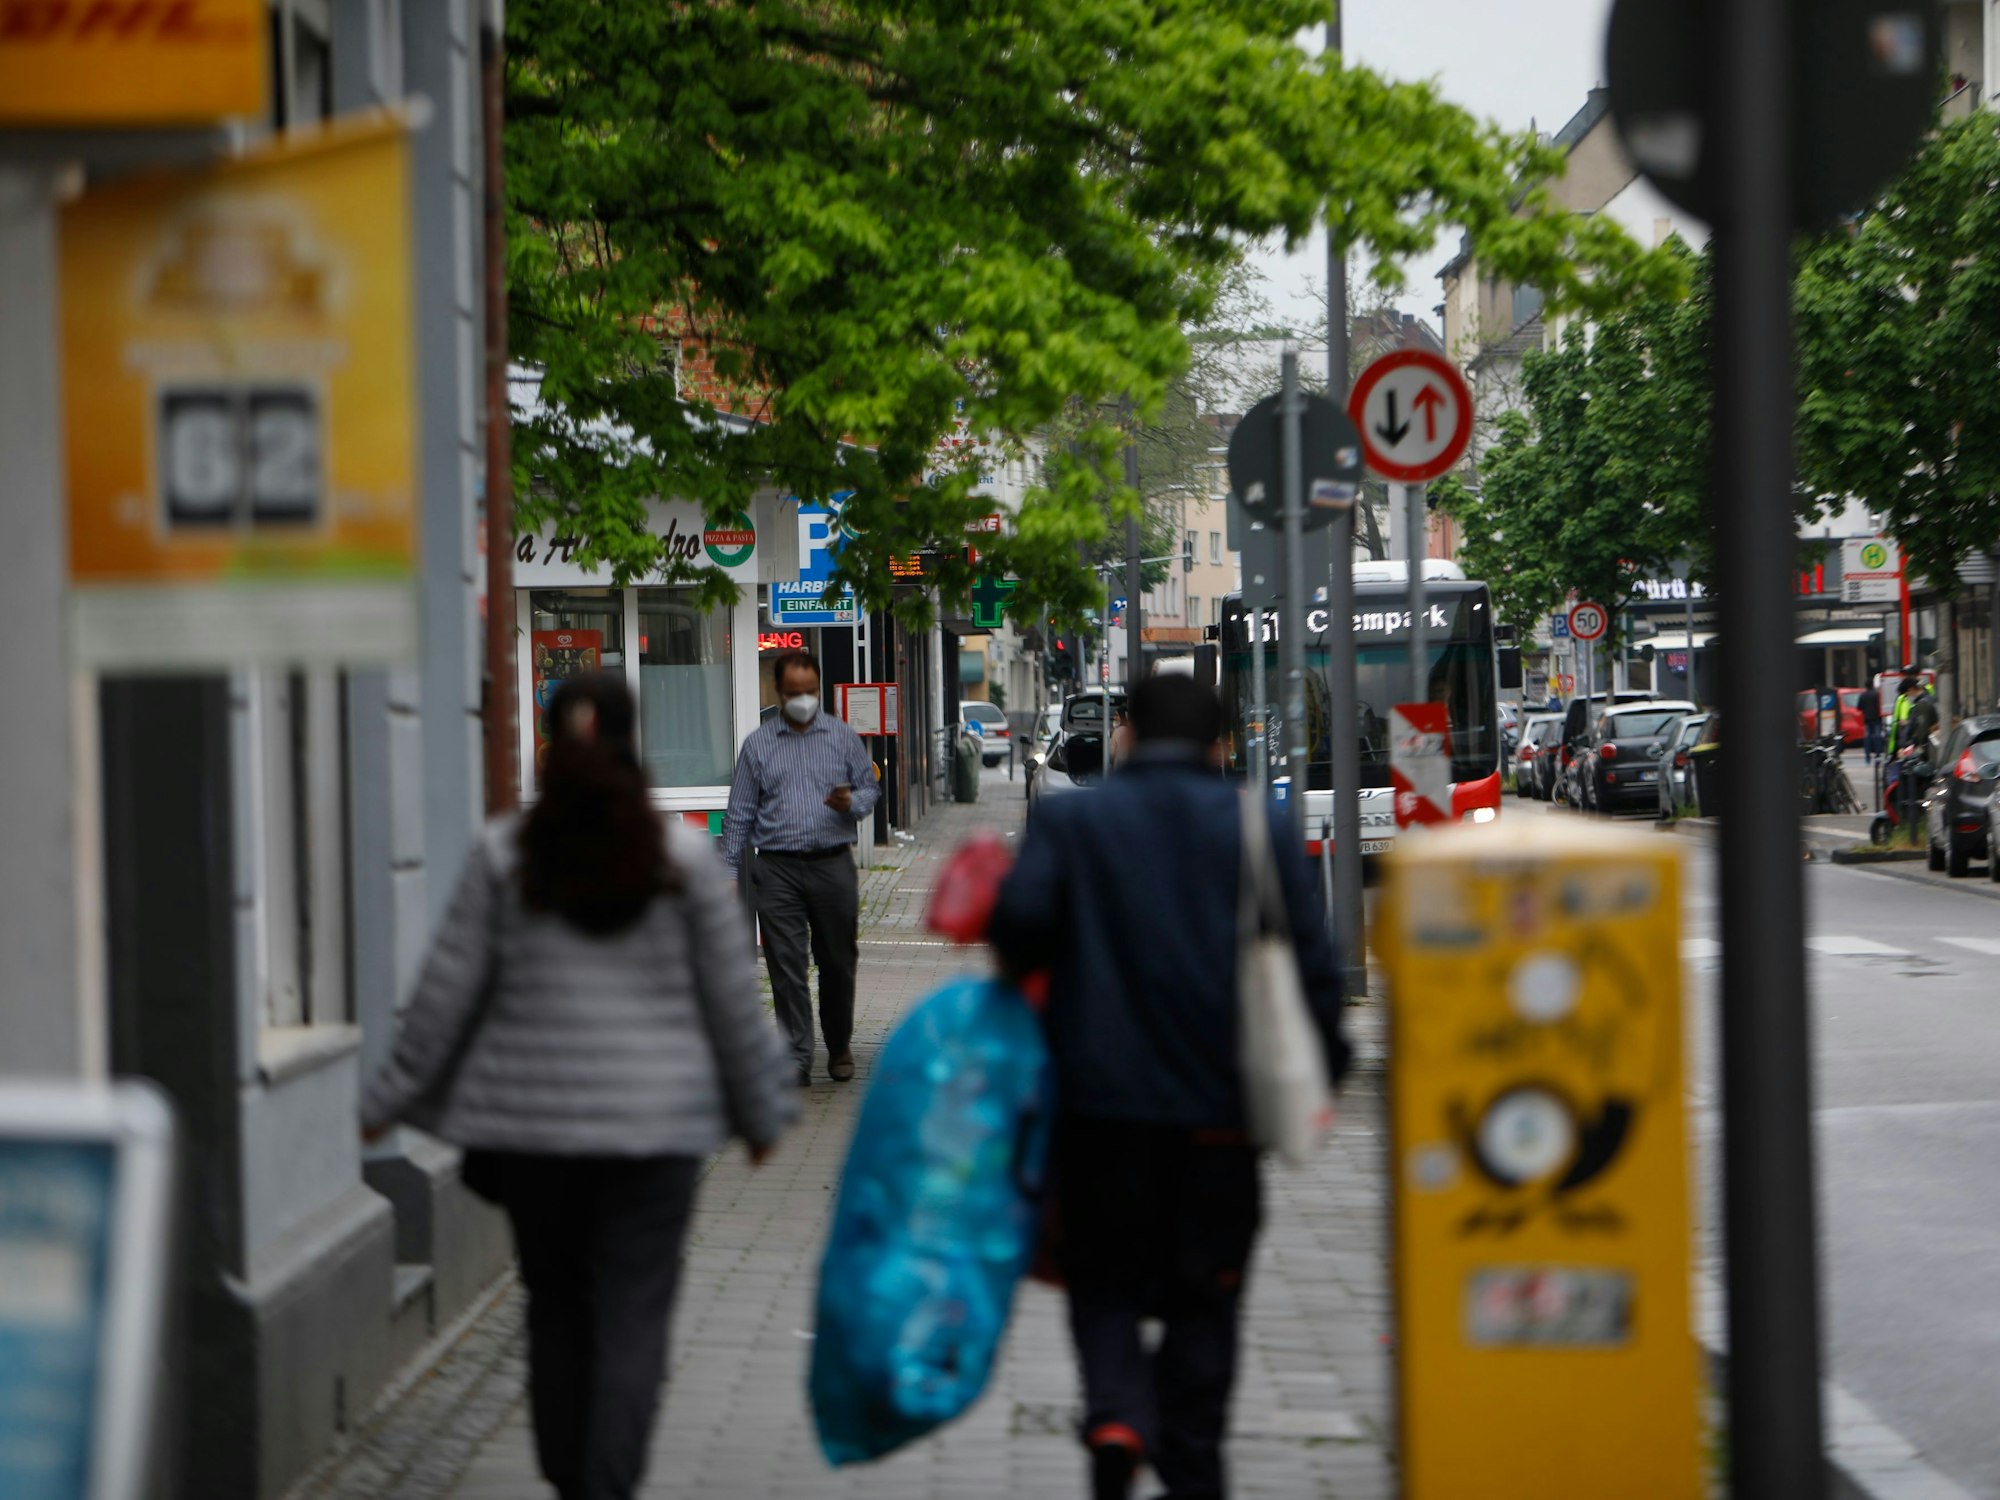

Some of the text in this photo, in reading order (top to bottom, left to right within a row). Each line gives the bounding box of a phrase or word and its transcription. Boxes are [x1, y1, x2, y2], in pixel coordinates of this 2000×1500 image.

[516, 533, 537, 563] a
[704, 534, 754, 542] PIZZA & PASTA
[798, 513, 840, 569] P
[1306, 604, 1449, 635] Cempak
[1576, 612, 1599, 630] 50
